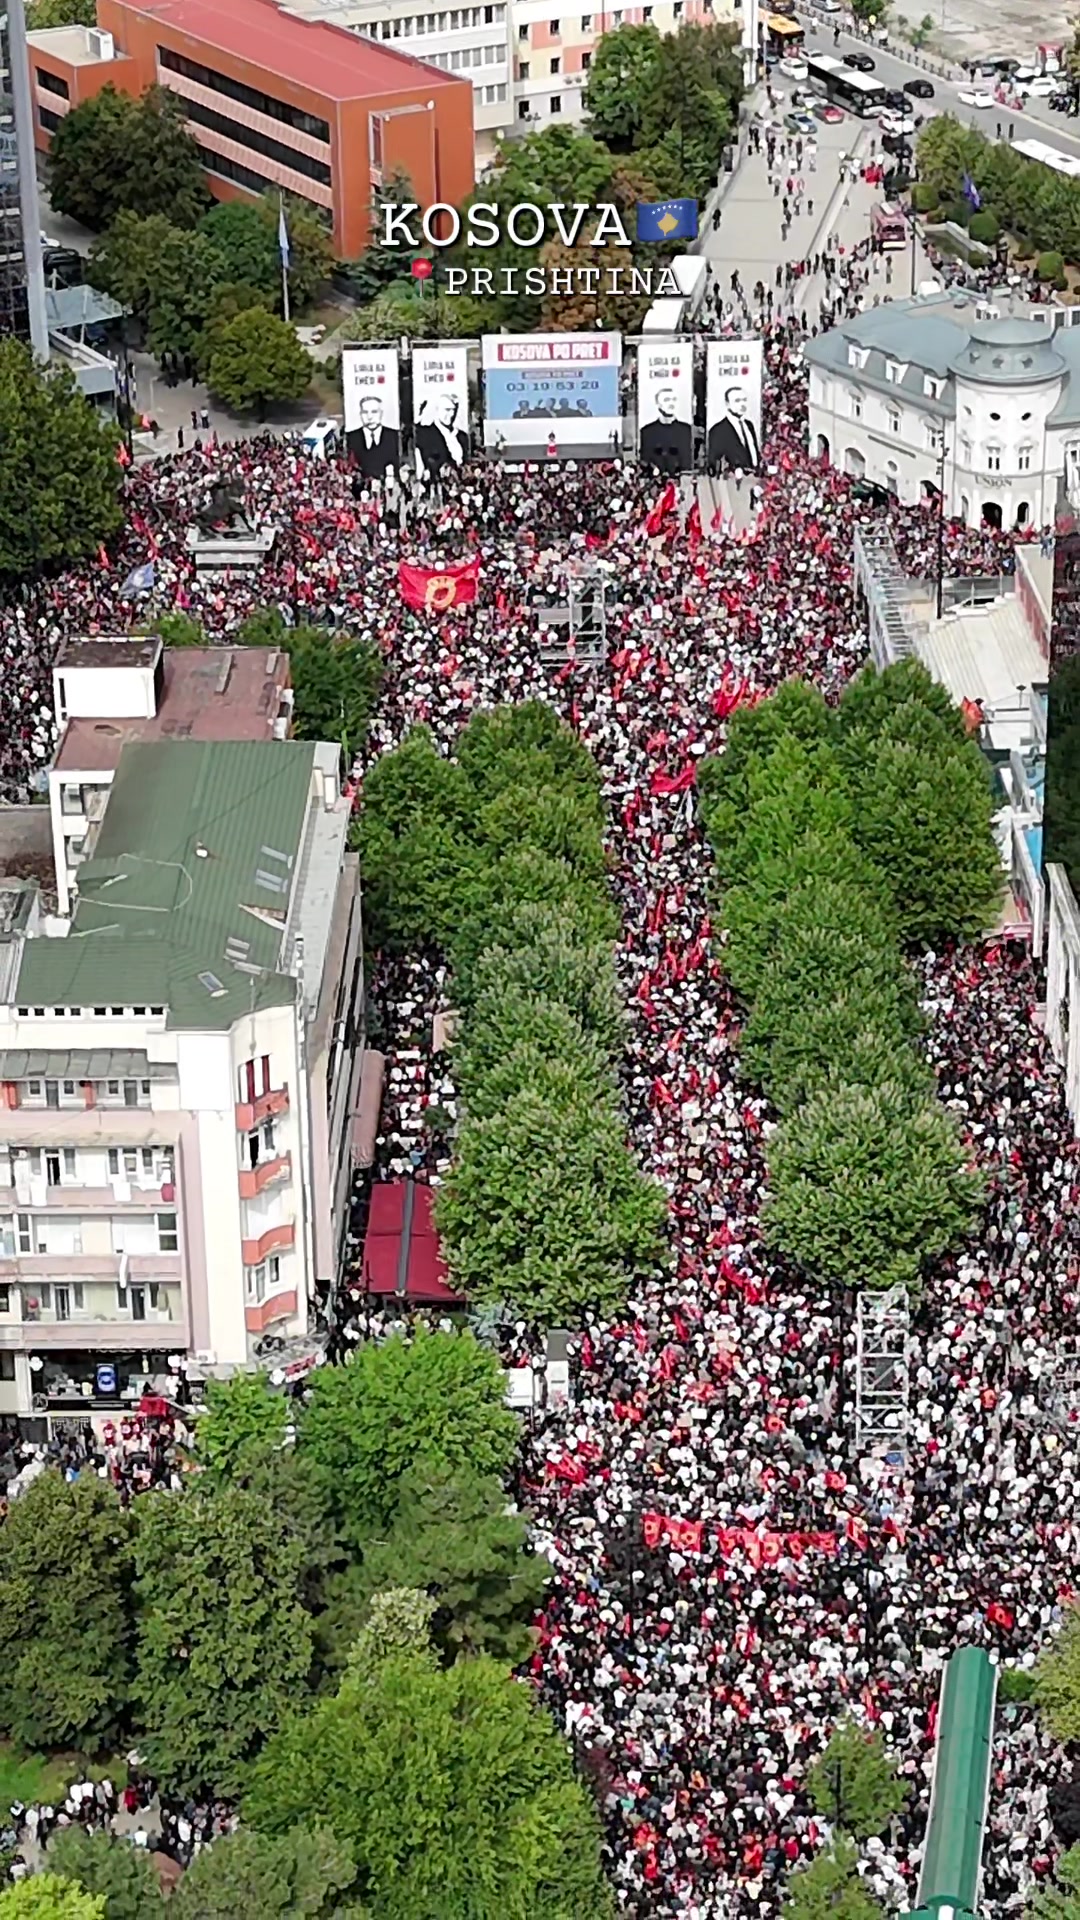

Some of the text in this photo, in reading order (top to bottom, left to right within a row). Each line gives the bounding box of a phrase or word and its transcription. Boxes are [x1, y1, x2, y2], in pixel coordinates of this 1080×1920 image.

[502, 341, 603, 360] KOSOVA PO PRET
[974, 474, 1012, 488] UNION
